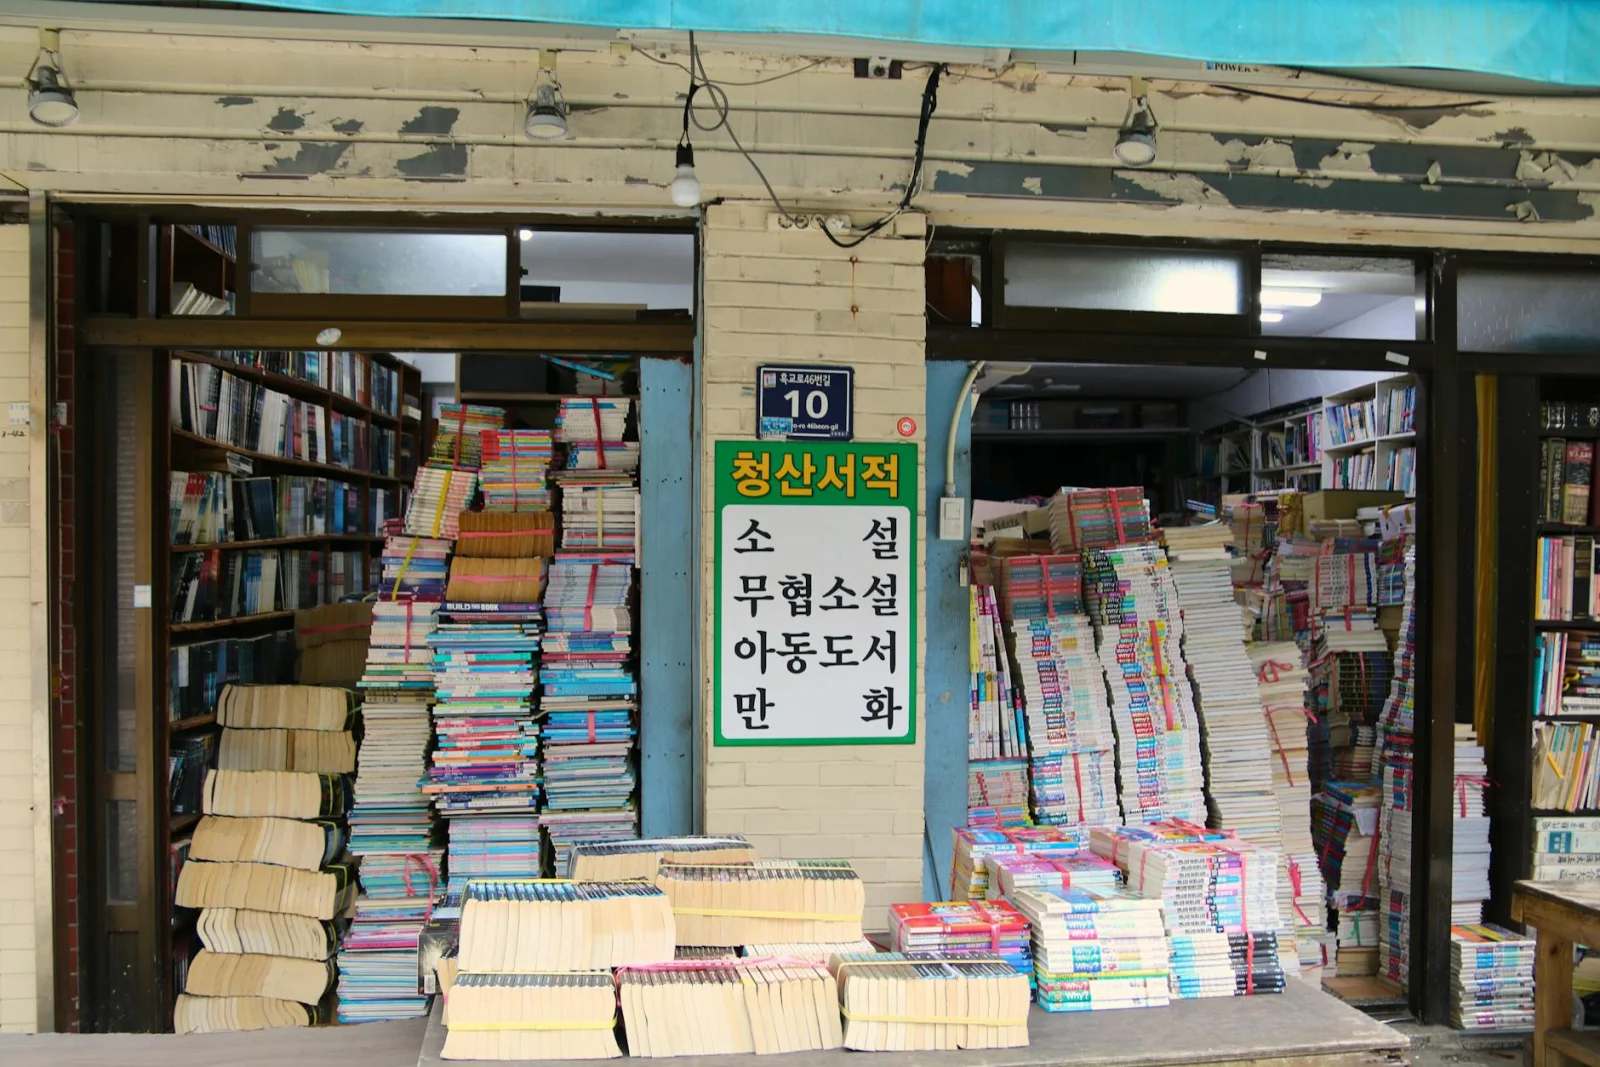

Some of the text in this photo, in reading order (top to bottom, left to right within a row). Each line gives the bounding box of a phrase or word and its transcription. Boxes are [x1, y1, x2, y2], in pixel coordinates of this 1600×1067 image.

[784, 390, 829, 419] 10
[731, 450, 900, 499] 청산서적
[733, 516, 899, 560] 소 설
[733, 573, 899, 618] 무협소설
[733, 629, 898, 675] 아동도서
[733, 686, 903, 731] 만 화
[1074, 946, 1100, 955] Why?
[1075, 962, 1100, 972] Why?
[1064, 981, 1089, 990] Why?
[1066, 991, 1089, 1000] Why?
